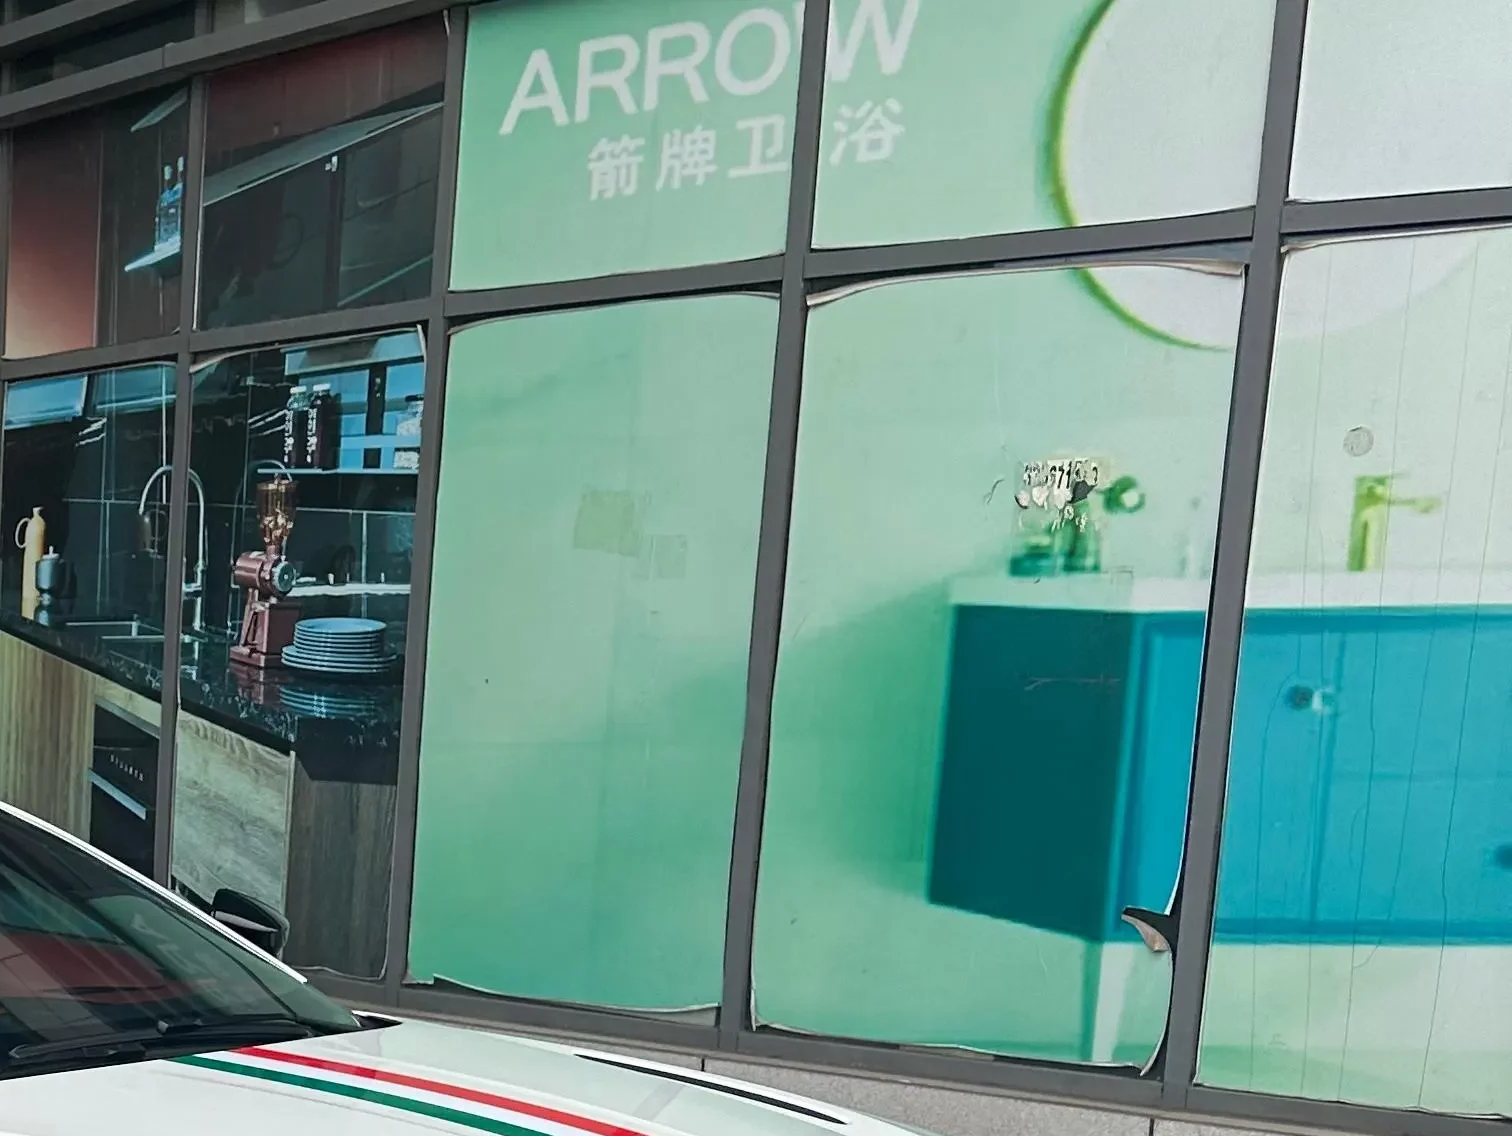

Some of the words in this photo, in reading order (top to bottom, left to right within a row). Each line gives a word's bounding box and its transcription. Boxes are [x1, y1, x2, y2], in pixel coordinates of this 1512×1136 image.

[499, 0, 919, 137] ARROW
[588, 97, 906, 200] 箭牌卫浴
